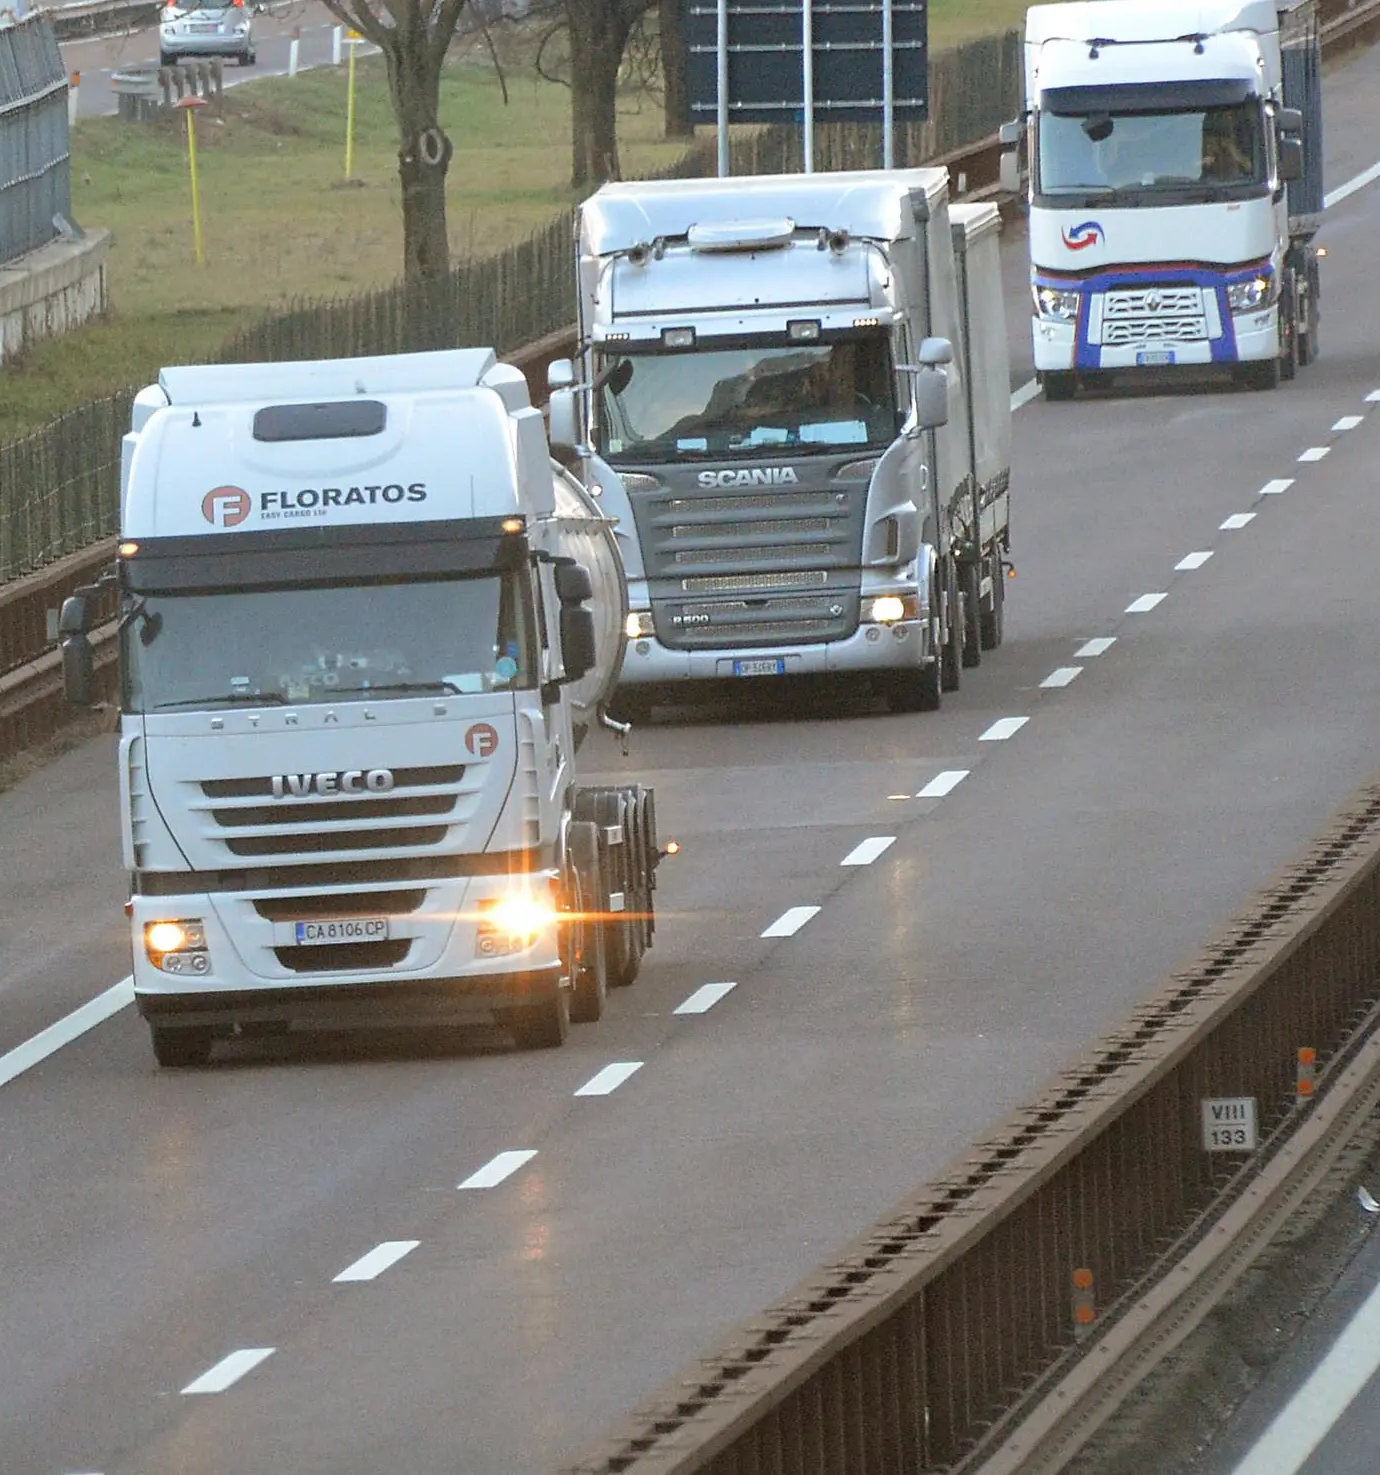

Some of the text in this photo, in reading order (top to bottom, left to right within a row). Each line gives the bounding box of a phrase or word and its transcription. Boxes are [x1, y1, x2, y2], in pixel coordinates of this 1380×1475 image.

[698, 466, 799, 489] SCANIA
[260, 483, 427, 511] FLORATOS
[272, 769, 394, 799] IVECO
[306, 921, 385, 939] CA 8106 CP
[1211, 1104, 1245, 1120] VIII
[1211, 1130, 1246, 1145] 133
